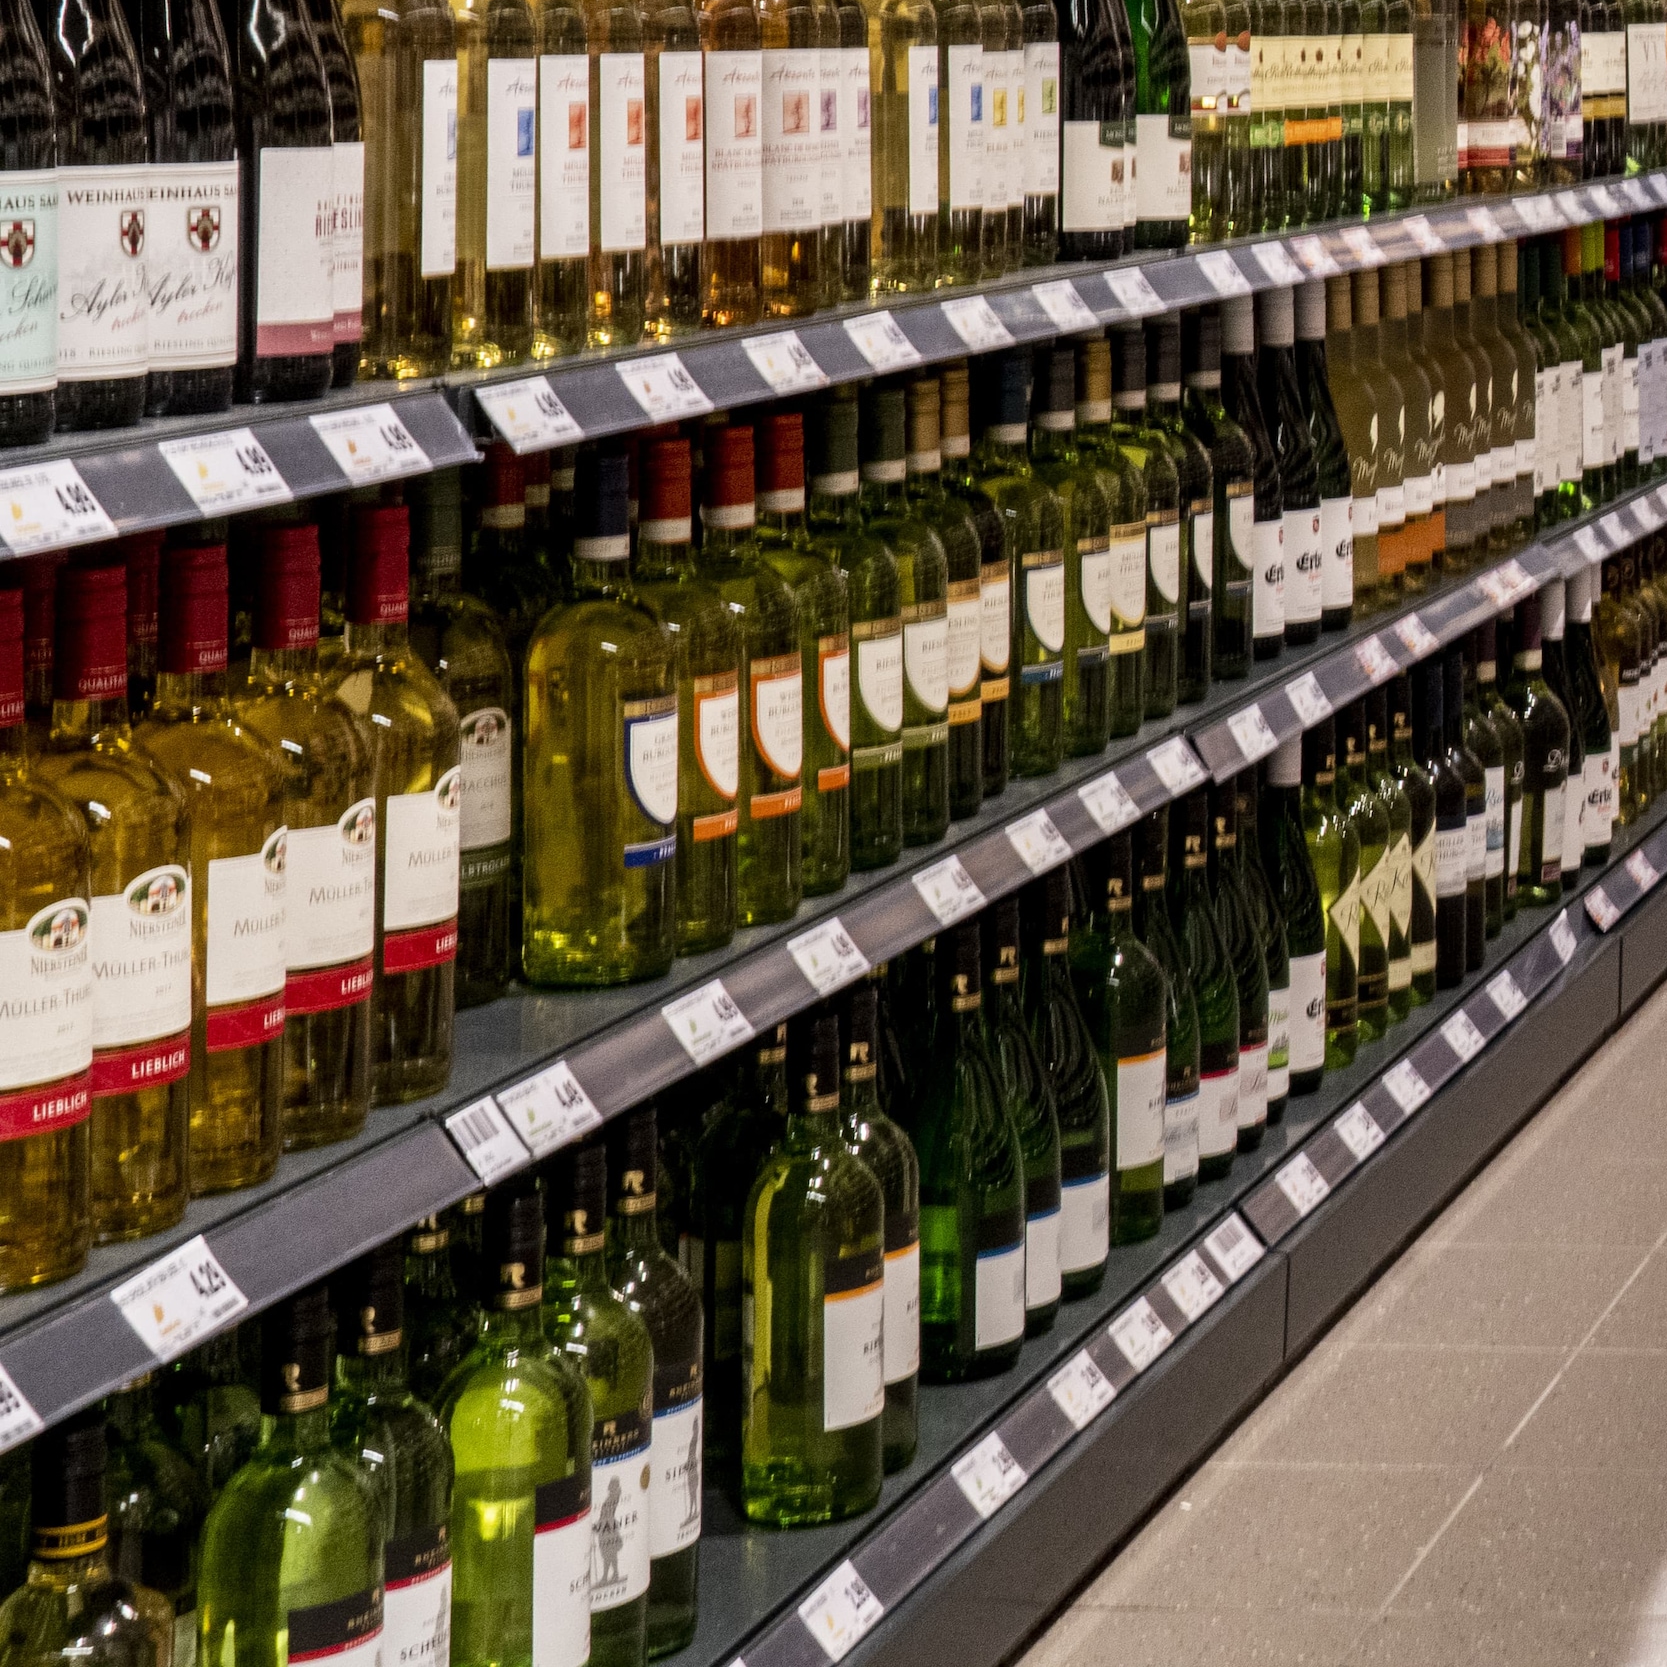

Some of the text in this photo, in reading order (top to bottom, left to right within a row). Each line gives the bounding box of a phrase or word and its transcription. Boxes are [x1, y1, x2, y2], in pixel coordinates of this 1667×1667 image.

[0, 193, 36, 210] AUS
[54, 481, 97, 515] 4.99
[131, 1050, 186, 1079] LIEBLICH
[33, 1091, 87, 1122] LIEBLICH
[190, 1259, 226, 1298] 4.29
